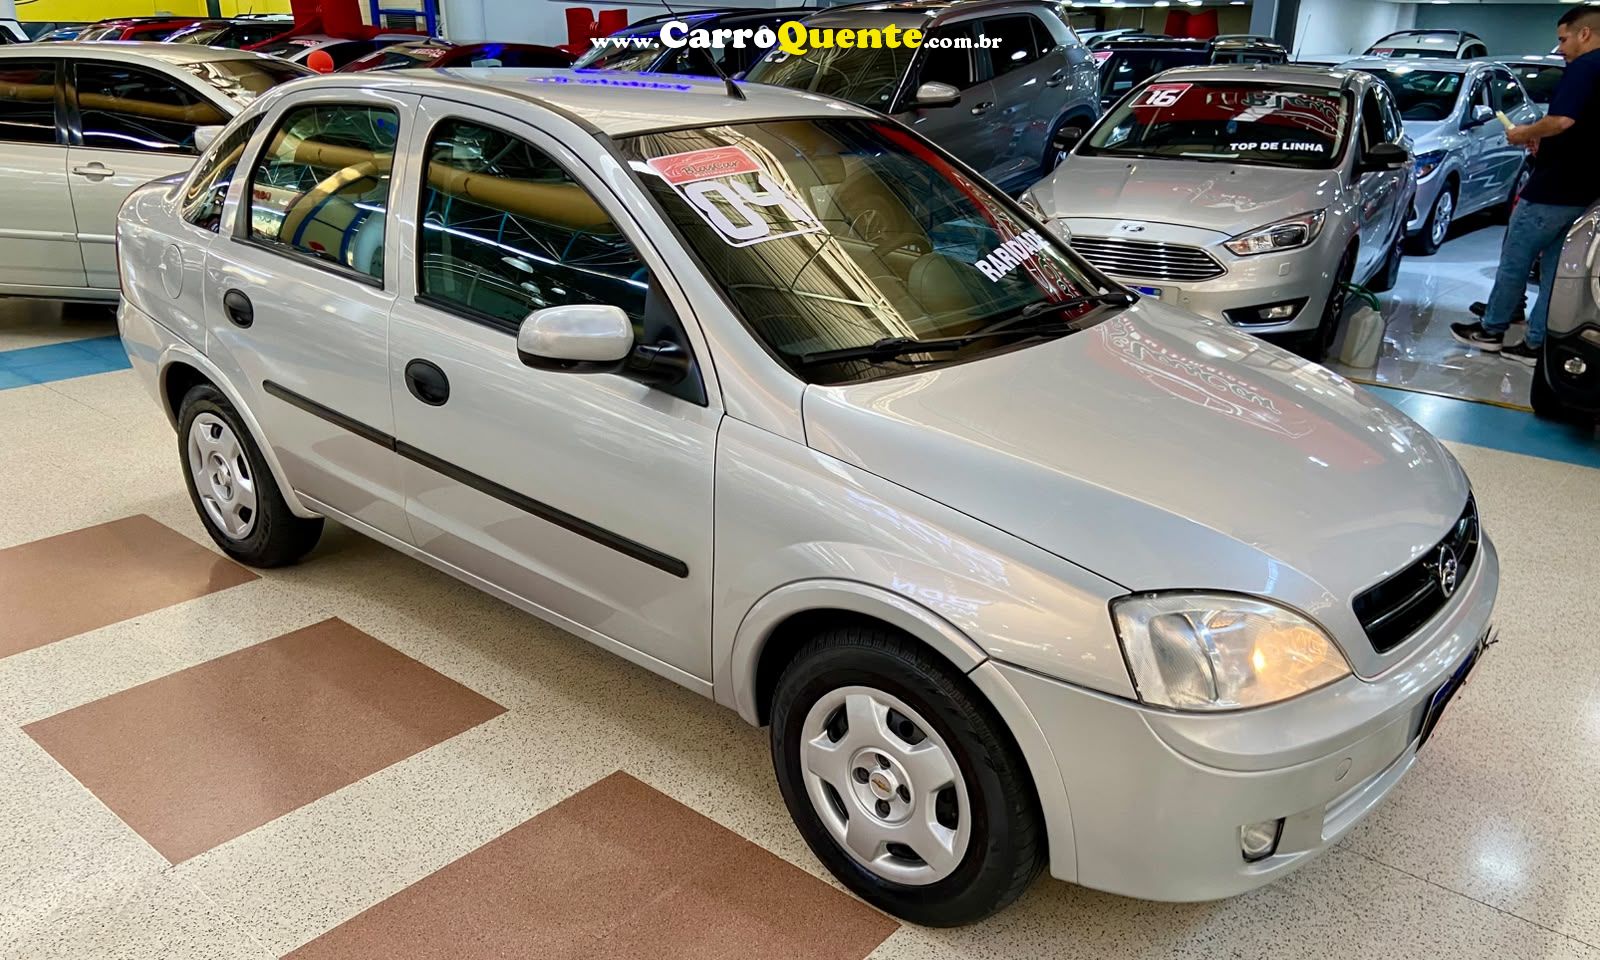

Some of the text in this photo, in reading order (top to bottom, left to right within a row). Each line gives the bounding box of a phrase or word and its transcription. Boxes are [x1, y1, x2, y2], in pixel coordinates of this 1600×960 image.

[1147, 90, 1180, 105] 16
[1230, 142, 1324, 152] TOP DE LINHA
[685, 174, 815, 240] 04
